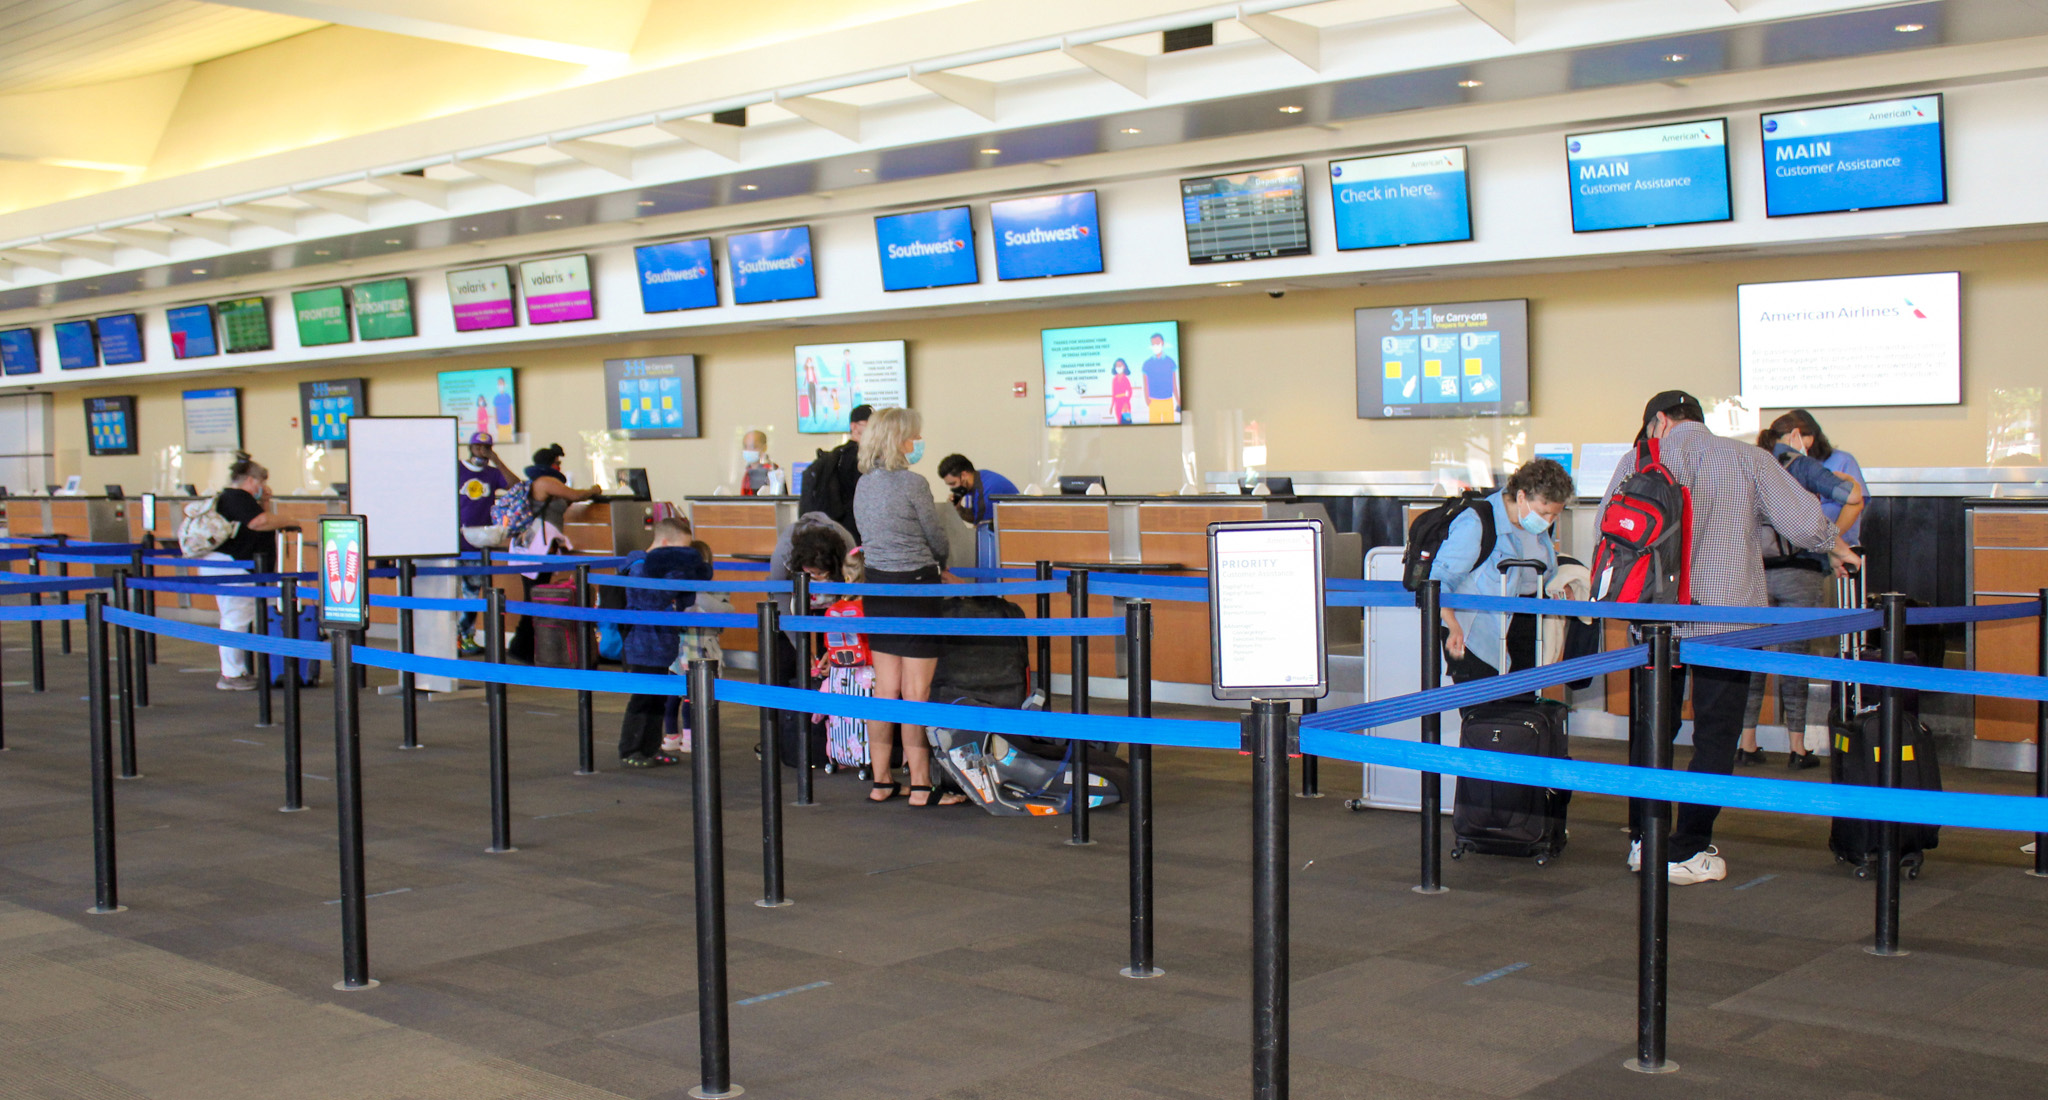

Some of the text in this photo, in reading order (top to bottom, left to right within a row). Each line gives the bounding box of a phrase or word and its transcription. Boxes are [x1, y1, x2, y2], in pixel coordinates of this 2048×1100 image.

[1868, 109, 1911, 121] American
[1661, 131, 1700, 143] American
[1775, 141, 1832, 162] MAIN
[1410, 159, 1443, 169] American
[1579, 161, 1629, 181] MAIN
[1775, 156, 1901, 178] Customer Assistance
[1255, 175, 1298, 187] Departures
[1579, 176, 1691, 196] Customer Assistance
[1340, 183, 1437, 204] Check in here.
[1004, 225, 1079, 246] Southwest
[888, 238, 955, 259] Southwest
[738, 255, 797, 274] Southwest
[531, 271, 564, 286] volaris
[644, 267, 699, 285] Southwest
[456, 280, 487, 294] volaris
[298, 306, 341, 322] FRONTIER
[358, 299, 405, 316] FRONTIER
[1760, 306, 1900, 322] American Airlines
[1432, 313, 1445, 323] for
[1446, 312, 1488, 323] Carry-ons
[1222, 559, 1277, 568] PRIORITY
